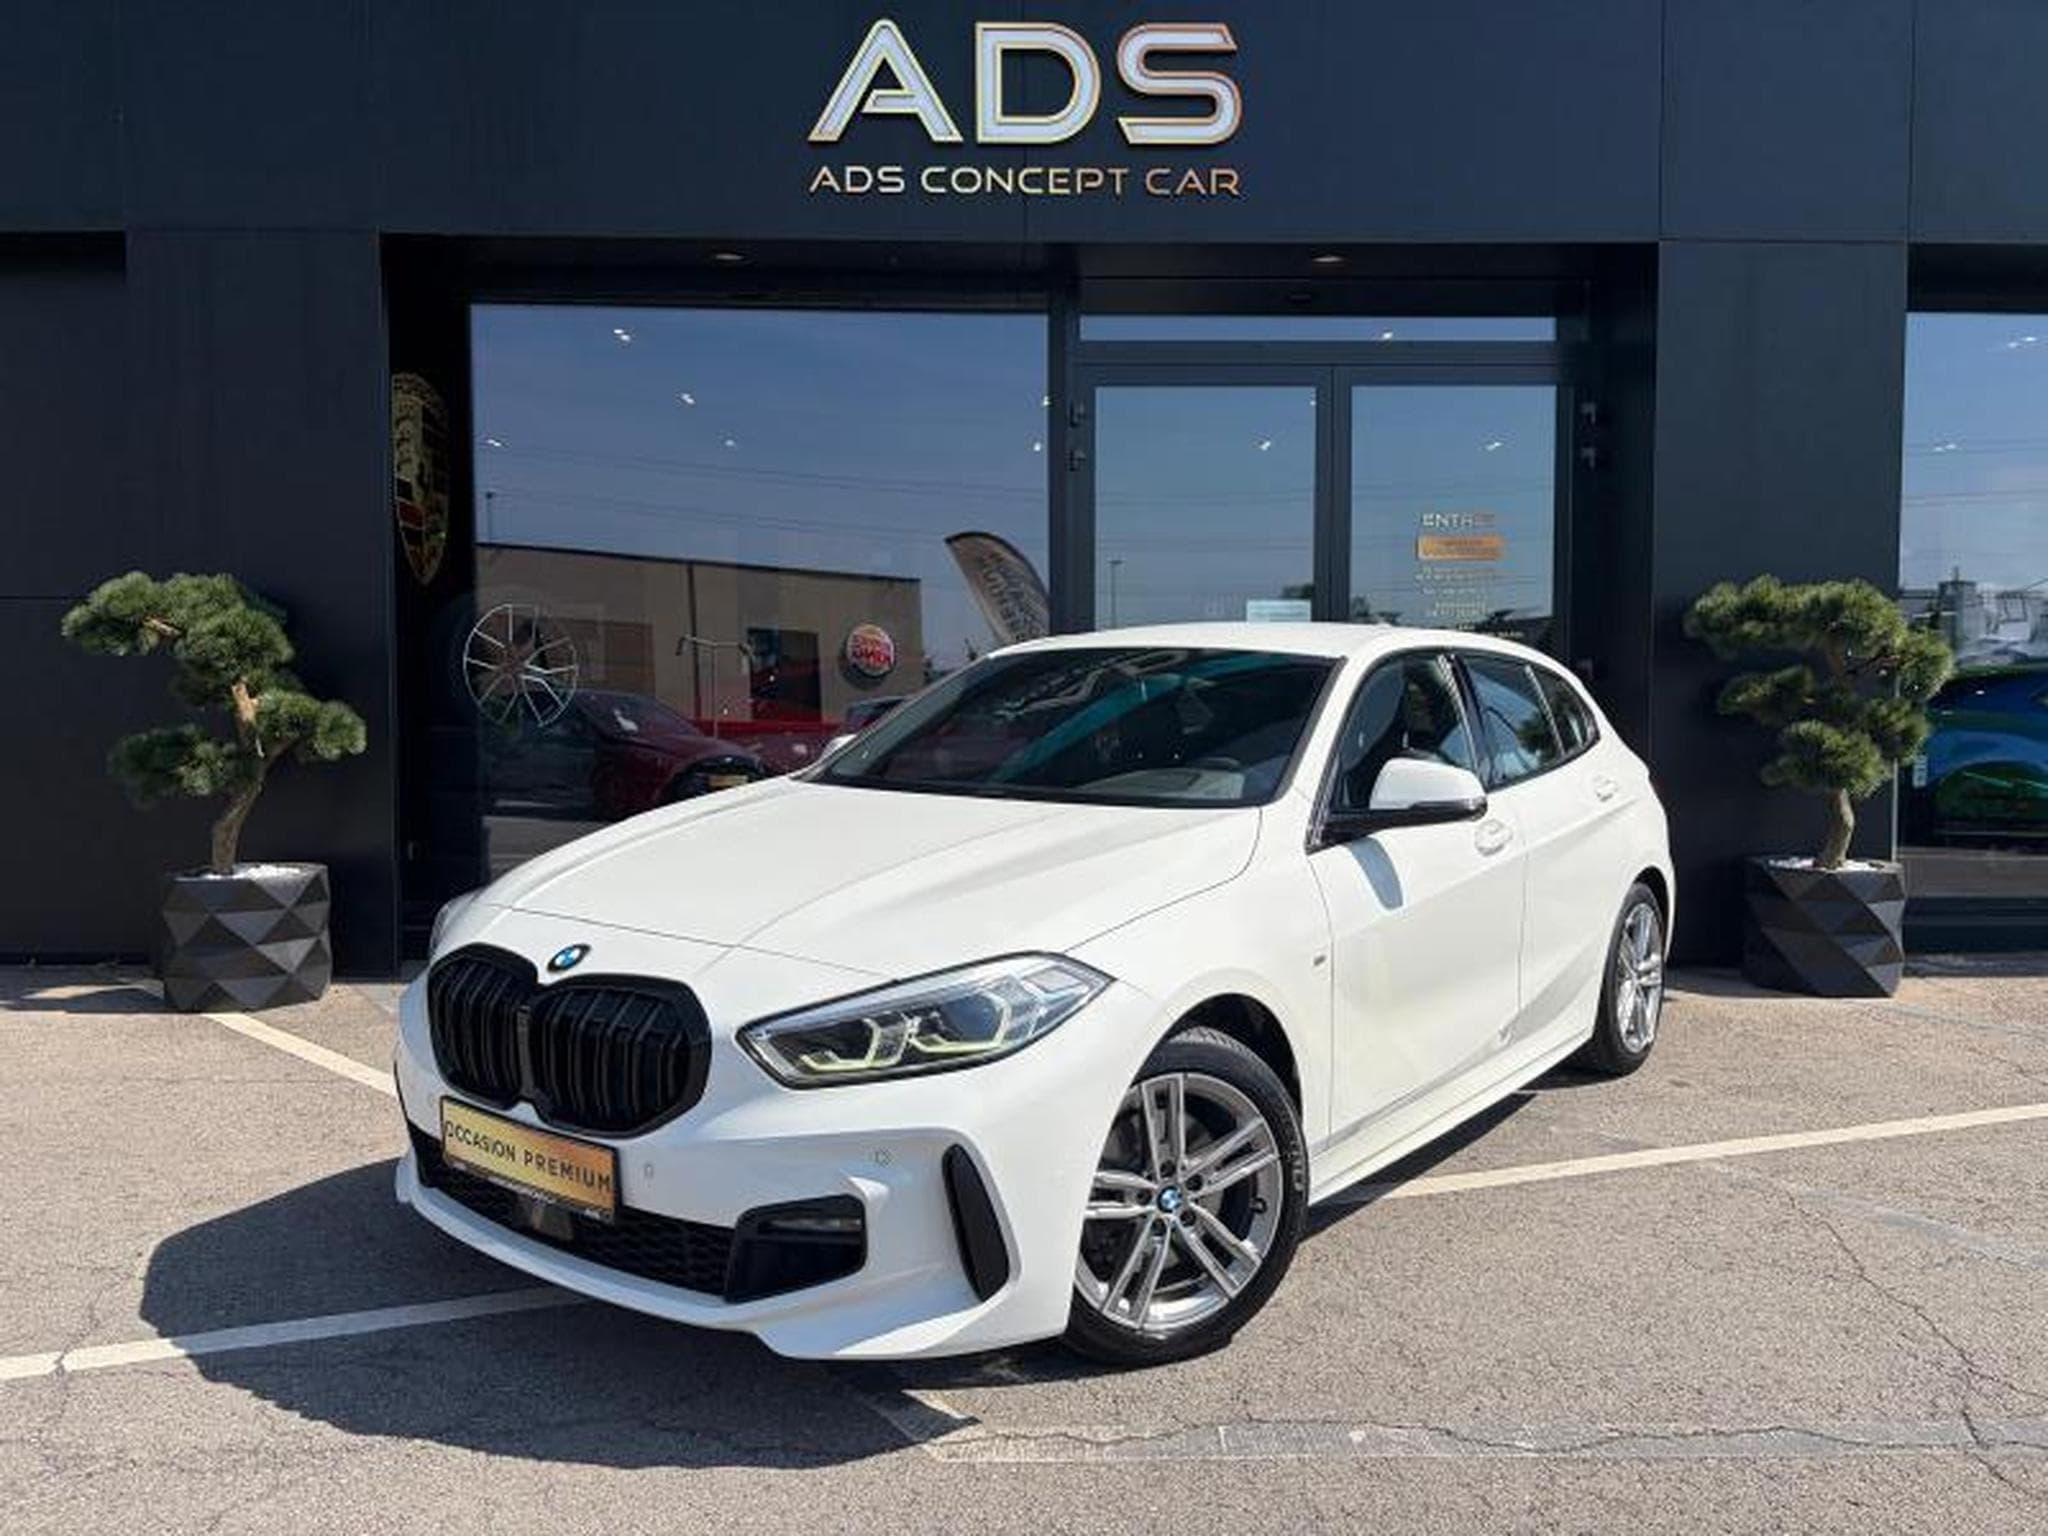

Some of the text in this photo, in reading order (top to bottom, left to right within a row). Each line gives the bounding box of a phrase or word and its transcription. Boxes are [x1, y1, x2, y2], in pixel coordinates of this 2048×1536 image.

[807, 18, 1243, 145] ADS
[809, 165, 1241, 196] ADS CONCEPT CAR
[444, 1121, 612, 1192] OCCASION PREMIUM
